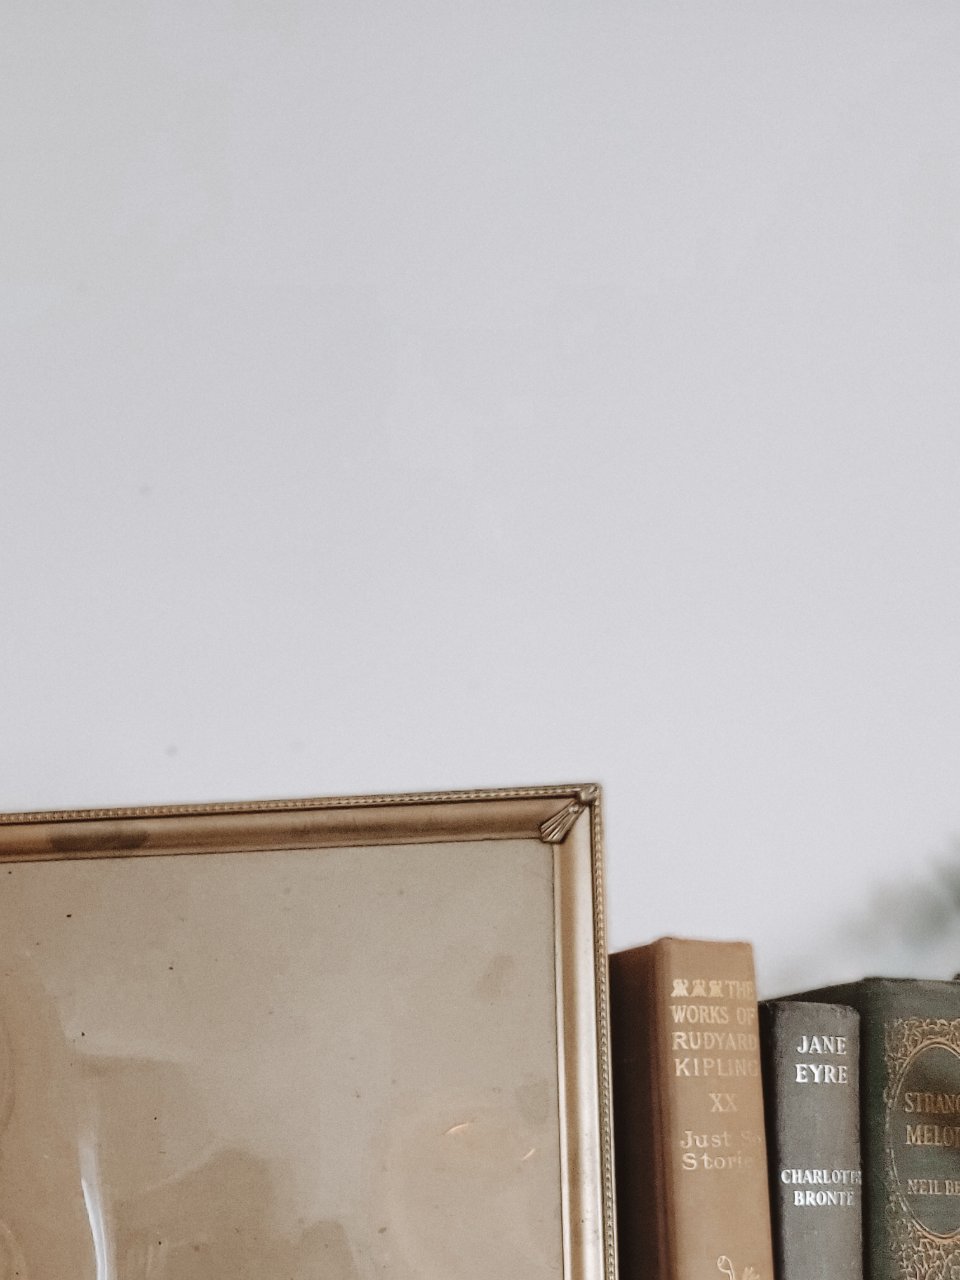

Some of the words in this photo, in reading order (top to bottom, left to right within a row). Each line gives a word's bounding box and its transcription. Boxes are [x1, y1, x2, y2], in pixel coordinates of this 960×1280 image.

[724, 980, 754, 1000] THE
[670, 1005, 729, 1024] WORKS
[736, 1007, 756, 1026] OF
[672, 1031, 757, 1051] RUDYARD
[797, 1035, 847, 1055] JANE
[674, 1057, 759, 1077] KIPLING
[795, 1063, 848, 1084] EYRE
[708, 1092, 737, 1112] XX
[680, 1130, 731, 1149] Just
[908, 1179, 942, 1195] NEIL
